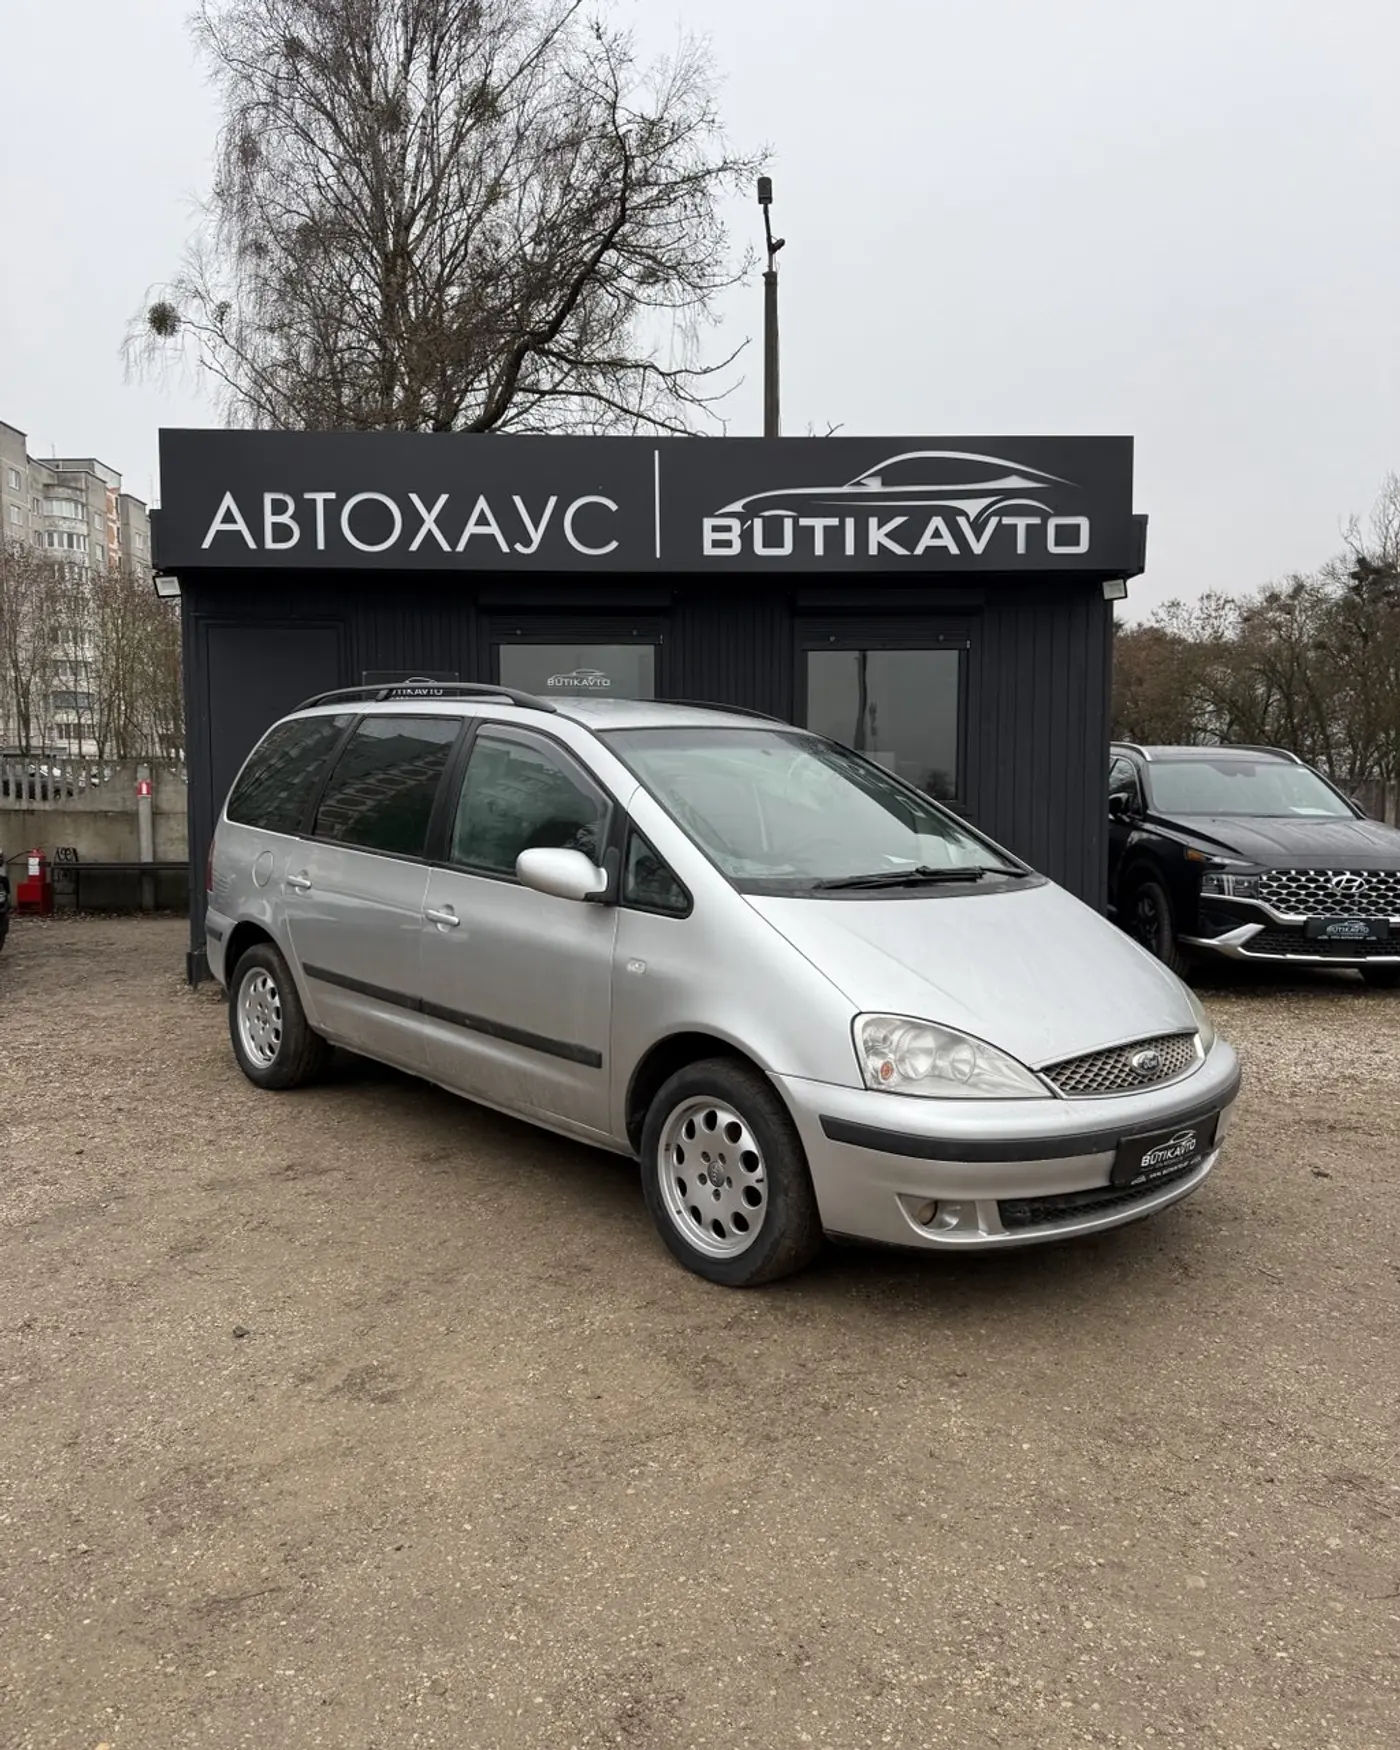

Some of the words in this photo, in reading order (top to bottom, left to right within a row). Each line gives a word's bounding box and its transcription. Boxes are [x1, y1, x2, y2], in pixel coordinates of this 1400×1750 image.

[201, 490, 620, 556] АВТОХАУС
[702, 515, 1090, 556] BUTIKAVTO
[547, 678, 611, 686] BUTIKAVTO
[1140, 1137, 1197, 1167] BUTIKAVTO
